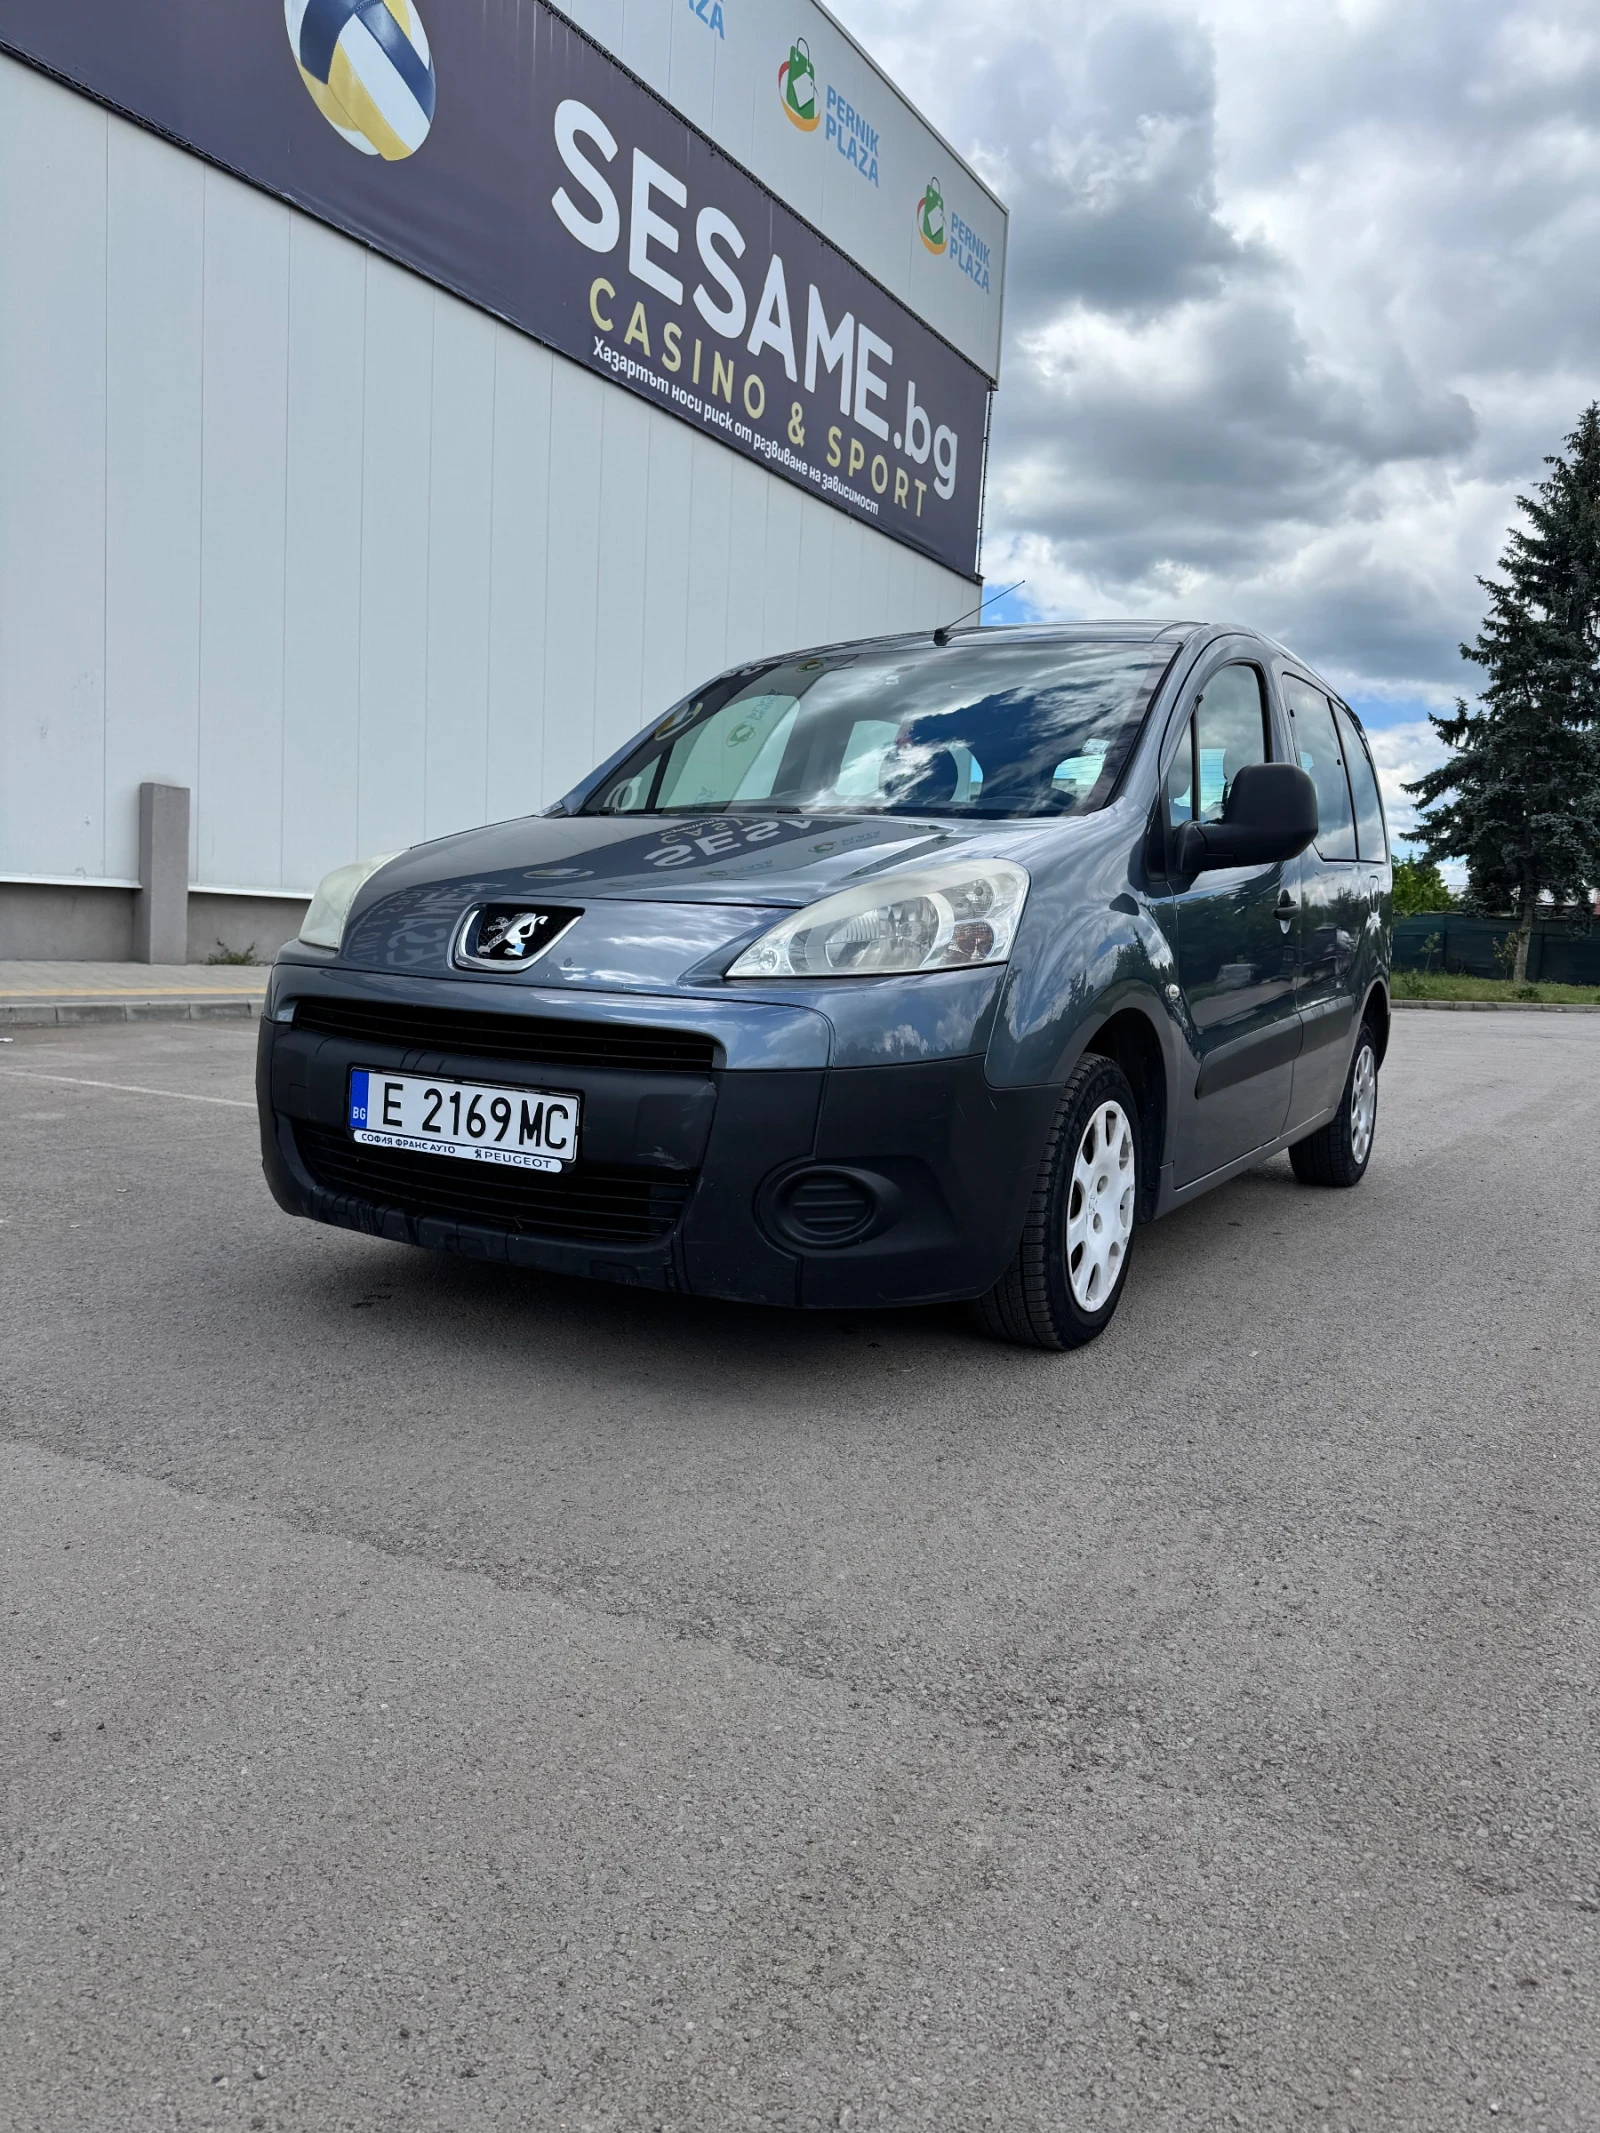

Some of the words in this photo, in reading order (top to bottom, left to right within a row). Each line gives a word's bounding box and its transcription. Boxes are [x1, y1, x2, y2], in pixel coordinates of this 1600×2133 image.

[826, 113, 879, 189] PLAZA
[827, 84, 880, 157] PERNIK
[949, 235, 990, 295] PLAZA
[951, 211, 990, 269] PERNIK
[551, 98, 958, 501] SESAME.bg
[589, 277, 765, 419] CASINO
[788, 401, 806, 447] &
[826, 426, 926, 517] SPORT
[593, 336, 669, 394] Хазартът
[671, 385, 702, 414] носи
[704, 403, 732, 432] риск
[734, 422, 752, 443] от
[754, 433, 808, 476] развиване
[809, 465, 821, 483] на
[821, 473, 879, 516] зависимост
[352, 1106, 366, 1120] BG
[361, 1133, 393, 1145] СОФИЯ
[395, 1138, 428, 1150] ФРАНС
[485, 1151, 552, 1169] PEUGEOT
